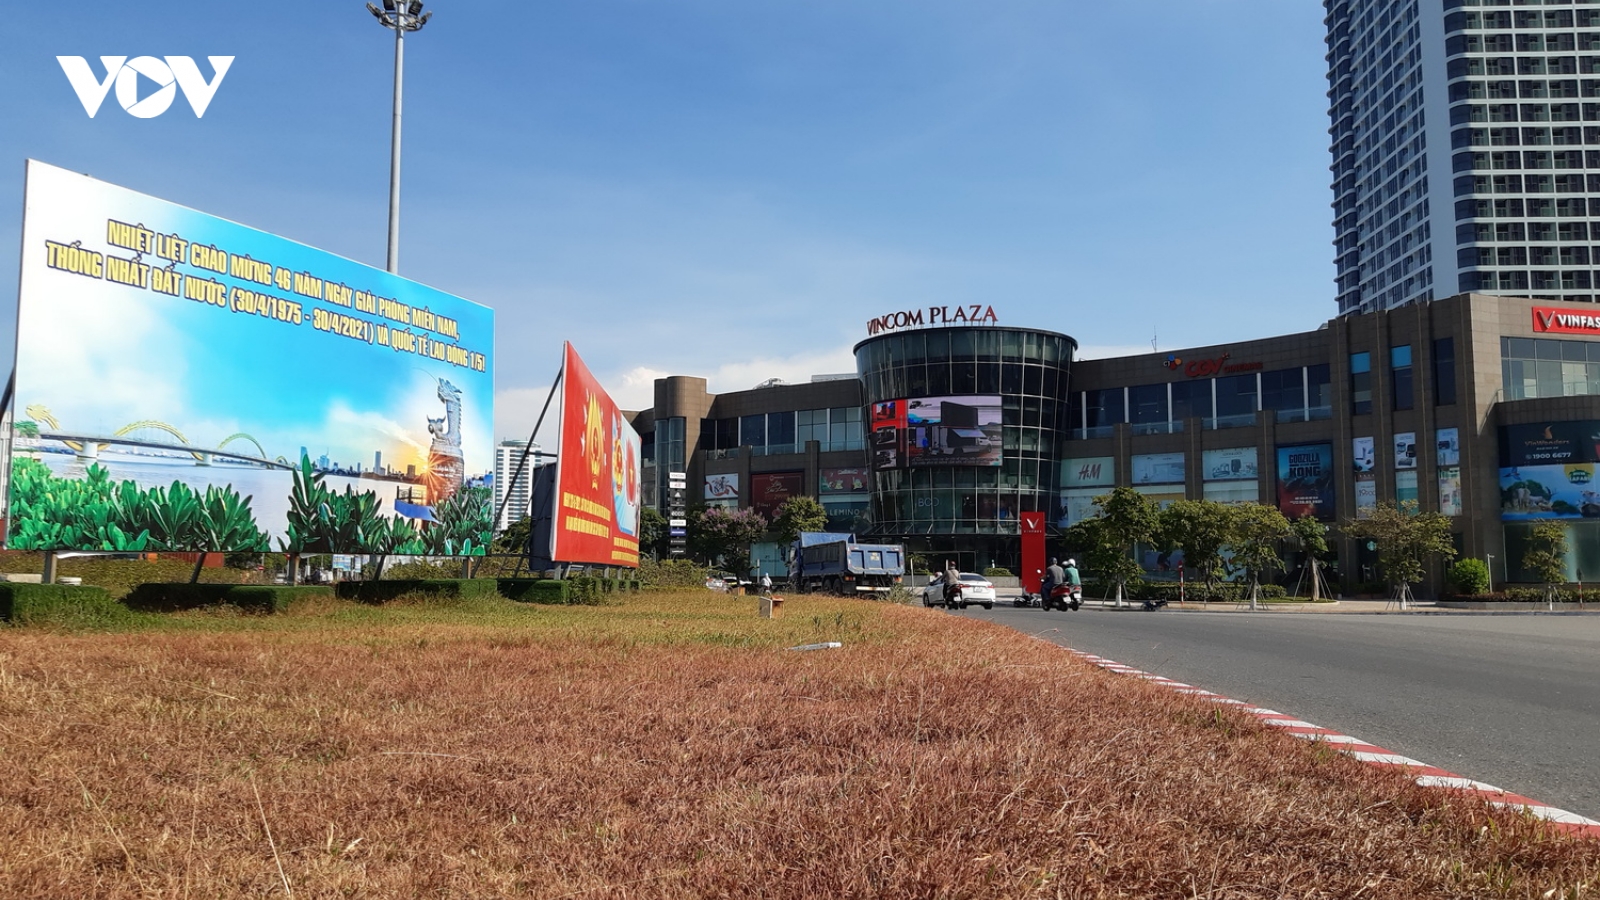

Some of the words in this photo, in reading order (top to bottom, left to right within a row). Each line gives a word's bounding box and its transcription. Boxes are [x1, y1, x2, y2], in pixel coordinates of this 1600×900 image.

[107, 219, 154, 257] NHIỆT
[157, 233, 188, 266] LIỆT
[191, 242, 228, 274] CHÀO
[230, 253, 272, 286] MỪNG
[274, 266, 291, 292] 46
[294, 271, 322, 300] NĂM
[325, 281, 353, 308] NGÀY
[355, 290, 376, 315] GIẢI
[379, 297, 410, 324] PHÓNG
[412, 306, 435, 332] MIỀN
[437, 315, 460, 342] NAM,
[46, 240, 103, 279] THỐNG
[106, 252, 149, 289] NHẤT
[152, 264, 182, 297] ĐẤT
[184, 275, 227, 307] NƯỚC
[230, 286, 302, 325] (30/4/1975
[304, 313, 310, 321] -
[313, 308, 374, 344] 30/4/2021)
[377, 323, 389, 347] VÀ
[391, 327, 416, 353] QUỐC
[417, 333, 429, 356] TẾ
[430, 339, 445, 361] LAO
[447, 343, 468, 367] ĐỘNG
[469, 351, 486, 373] 1/5!
[867, 309, 925, 336] VINCOM
[929, 305, 998, 324] PLAZA
[1184, 358, 1225, 377] CGV
[1289, 453, 1320, 463] GODZILLA
[1078, 463, 1102, 480] H&M
[1289, 466, 1321, 477] KONG
